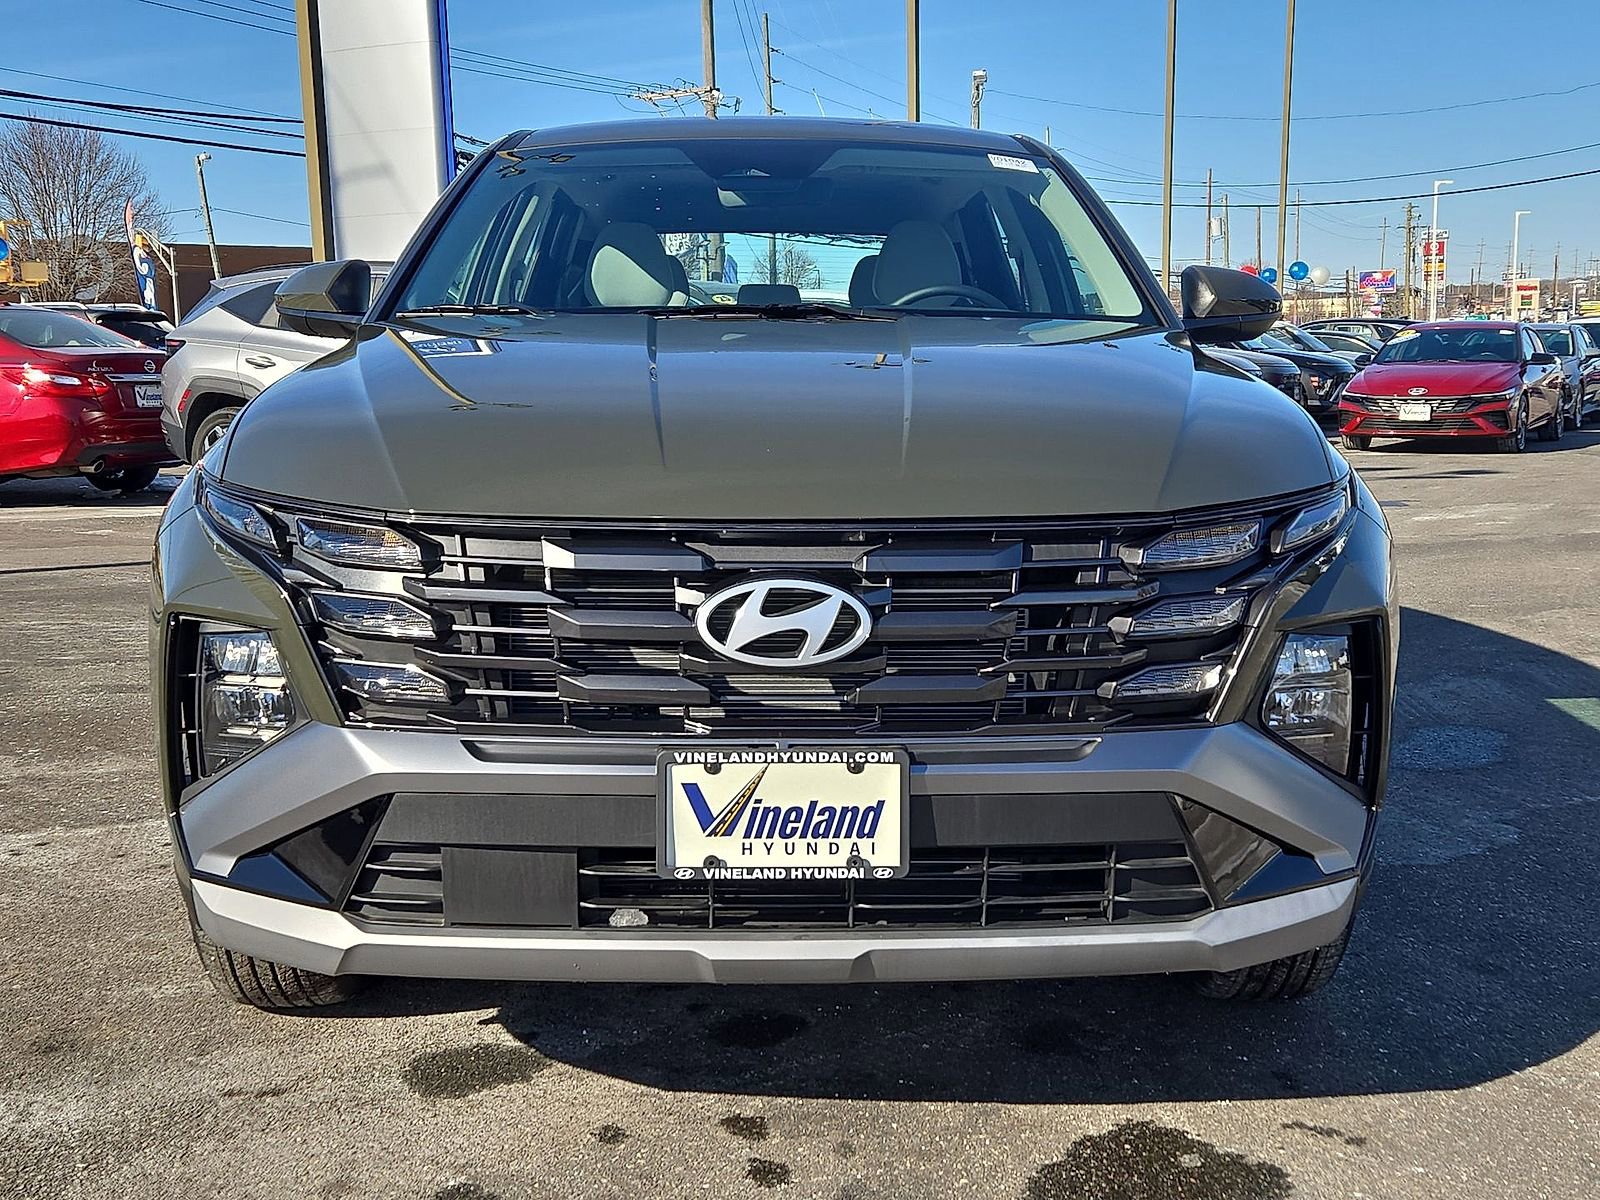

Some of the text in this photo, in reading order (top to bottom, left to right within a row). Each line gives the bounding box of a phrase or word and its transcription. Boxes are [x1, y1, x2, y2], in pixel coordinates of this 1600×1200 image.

[674, 751, 894, 764] VINELANDHYUNDAI.COM
[680, 766, 886, 840] Vineland
[742, 841, 876, 856] HYUNDAI
[702, 867, 865, 880] VINELAND HYUNDAI
